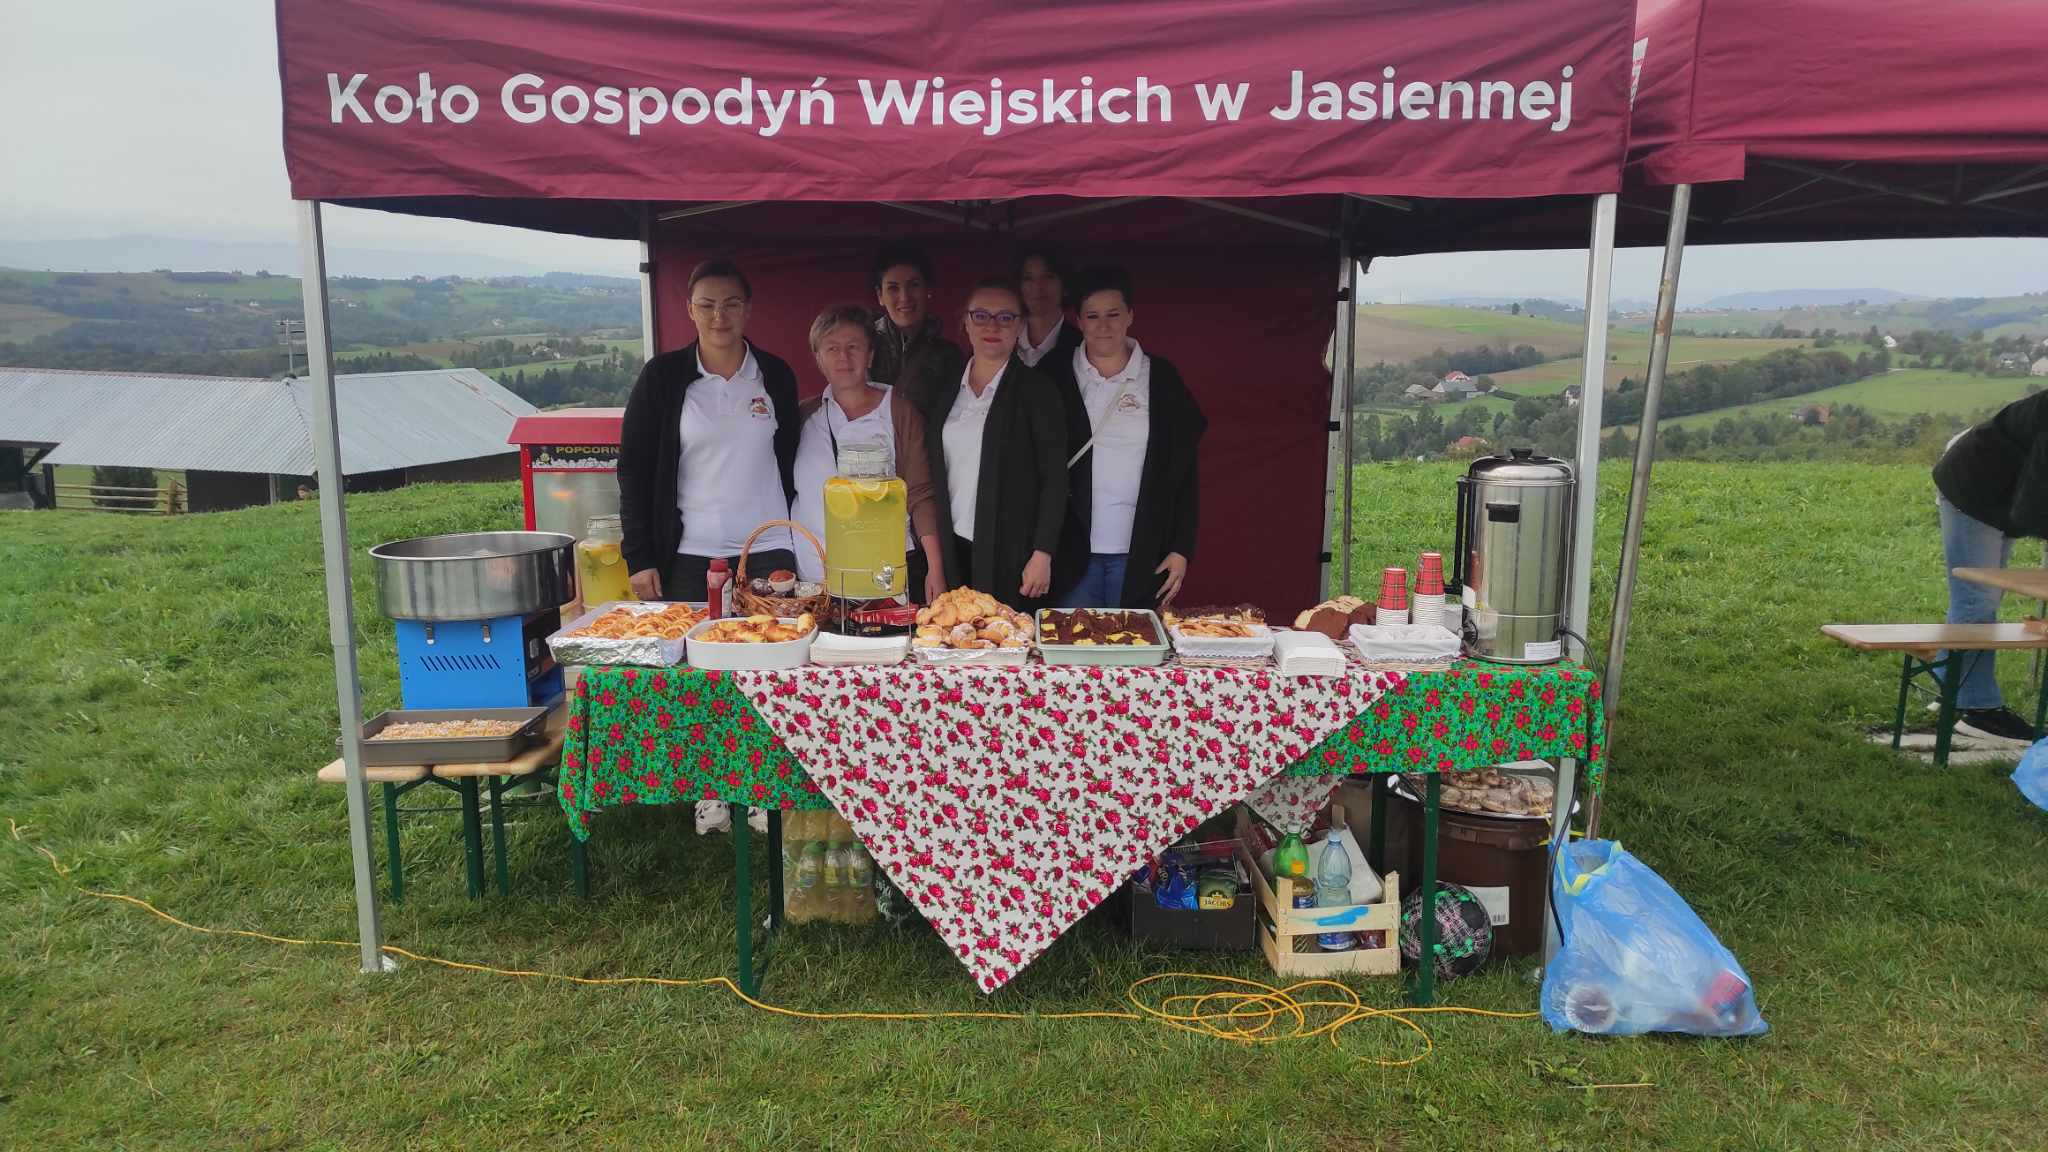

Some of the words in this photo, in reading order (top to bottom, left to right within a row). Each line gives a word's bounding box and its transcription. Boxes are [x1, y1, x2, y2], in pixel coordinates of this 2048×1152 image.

[327, 72, 480, 124] Koło
[500, 73, 835, 137] Gospodyń
[857, 76, 1172, 136] Wiejskich
[1194, 82, 1250, 121] w
[1269, 65, 1574, 132] Jasiennej
[555, 446, 620, 454] POPCORN
